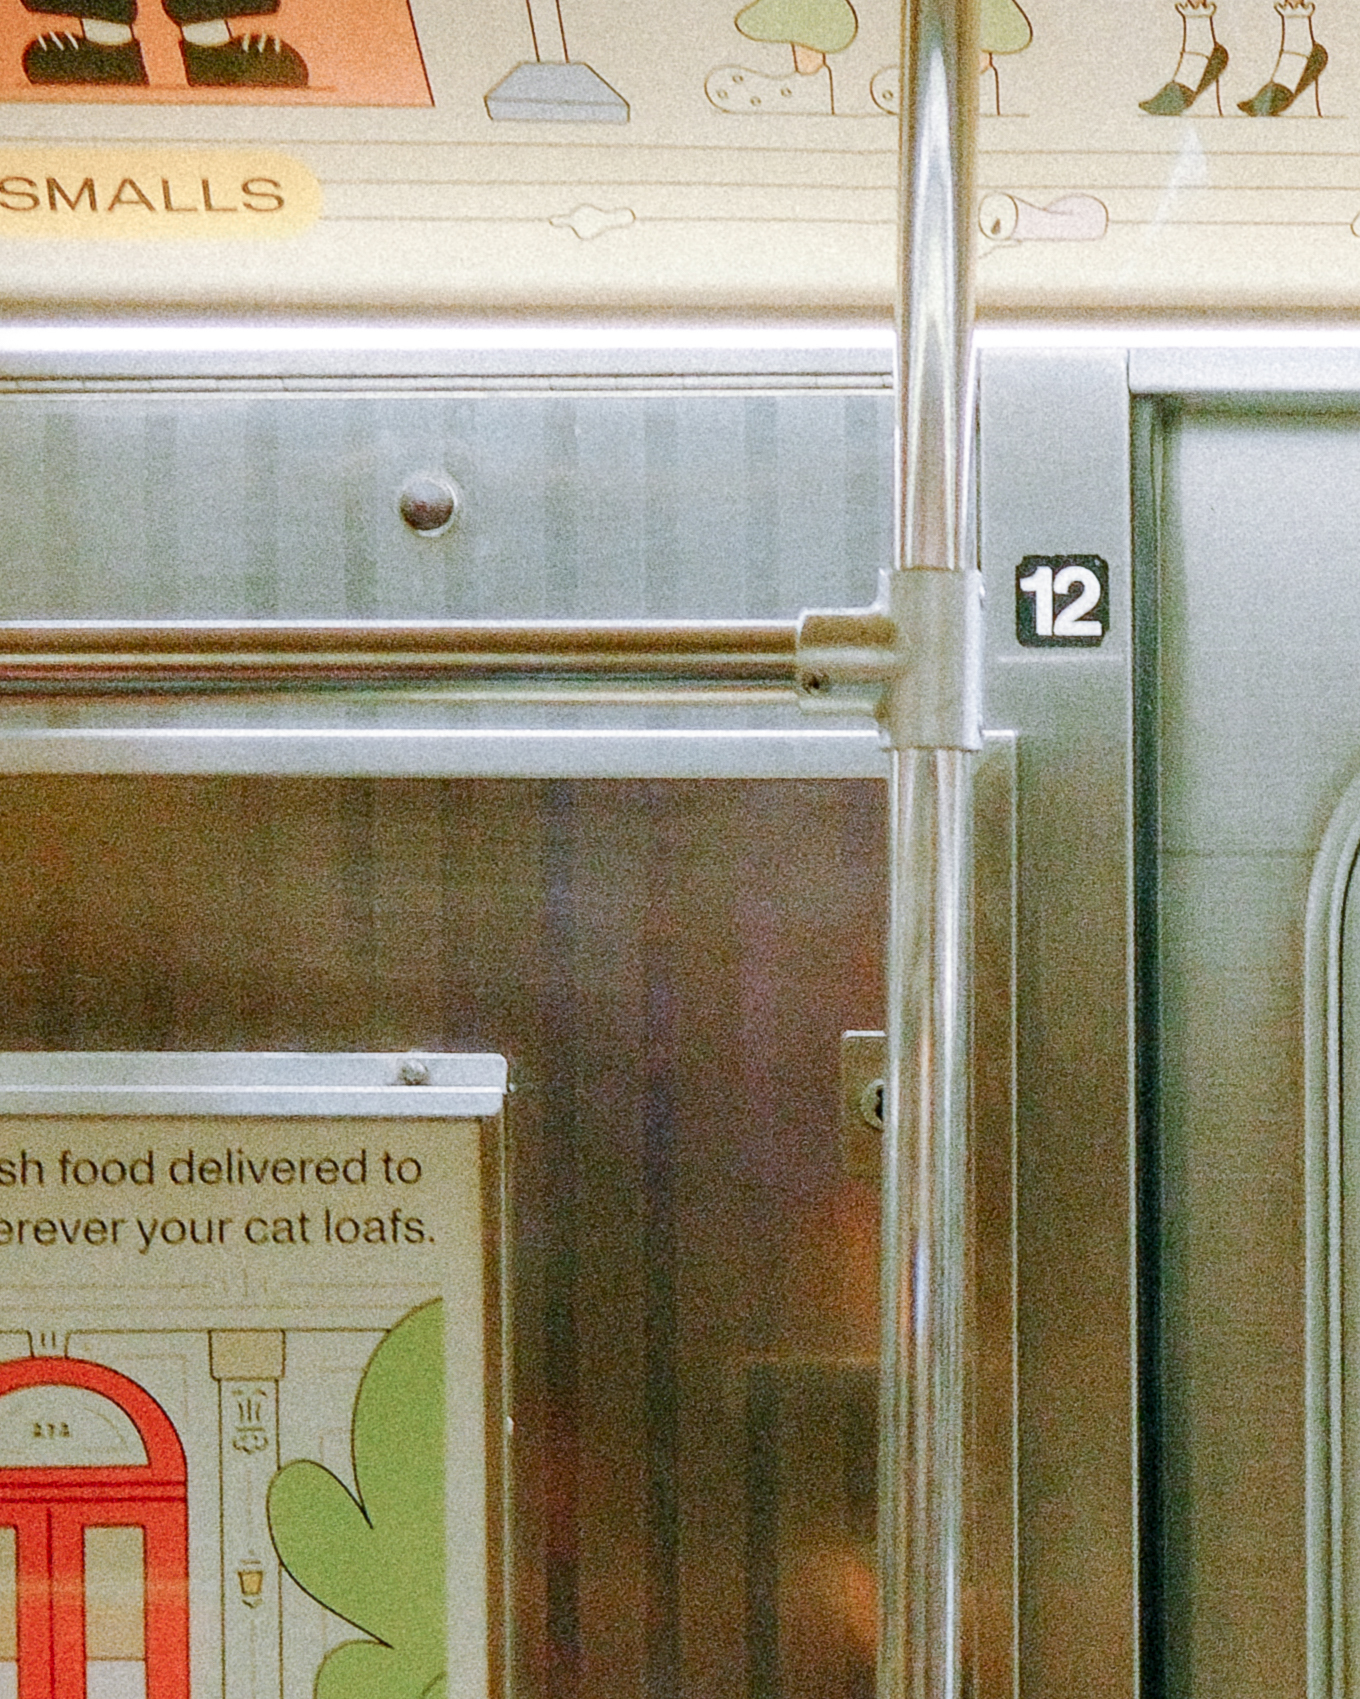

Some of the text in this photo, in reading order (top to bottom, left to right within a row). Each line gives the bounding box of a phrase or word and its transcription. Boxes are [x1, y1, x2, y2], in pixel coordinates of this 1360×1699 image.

[0, 176, 285, 212] SMALLS
[1019, 565, 1103, 637] 12
[0, 1149, 422, 1186] sh food delivered to
[136, 1217, 236, 1255] your
[244, 1212, 309, 1245] cat
[324, 1208, 435, 1245] loafs.
